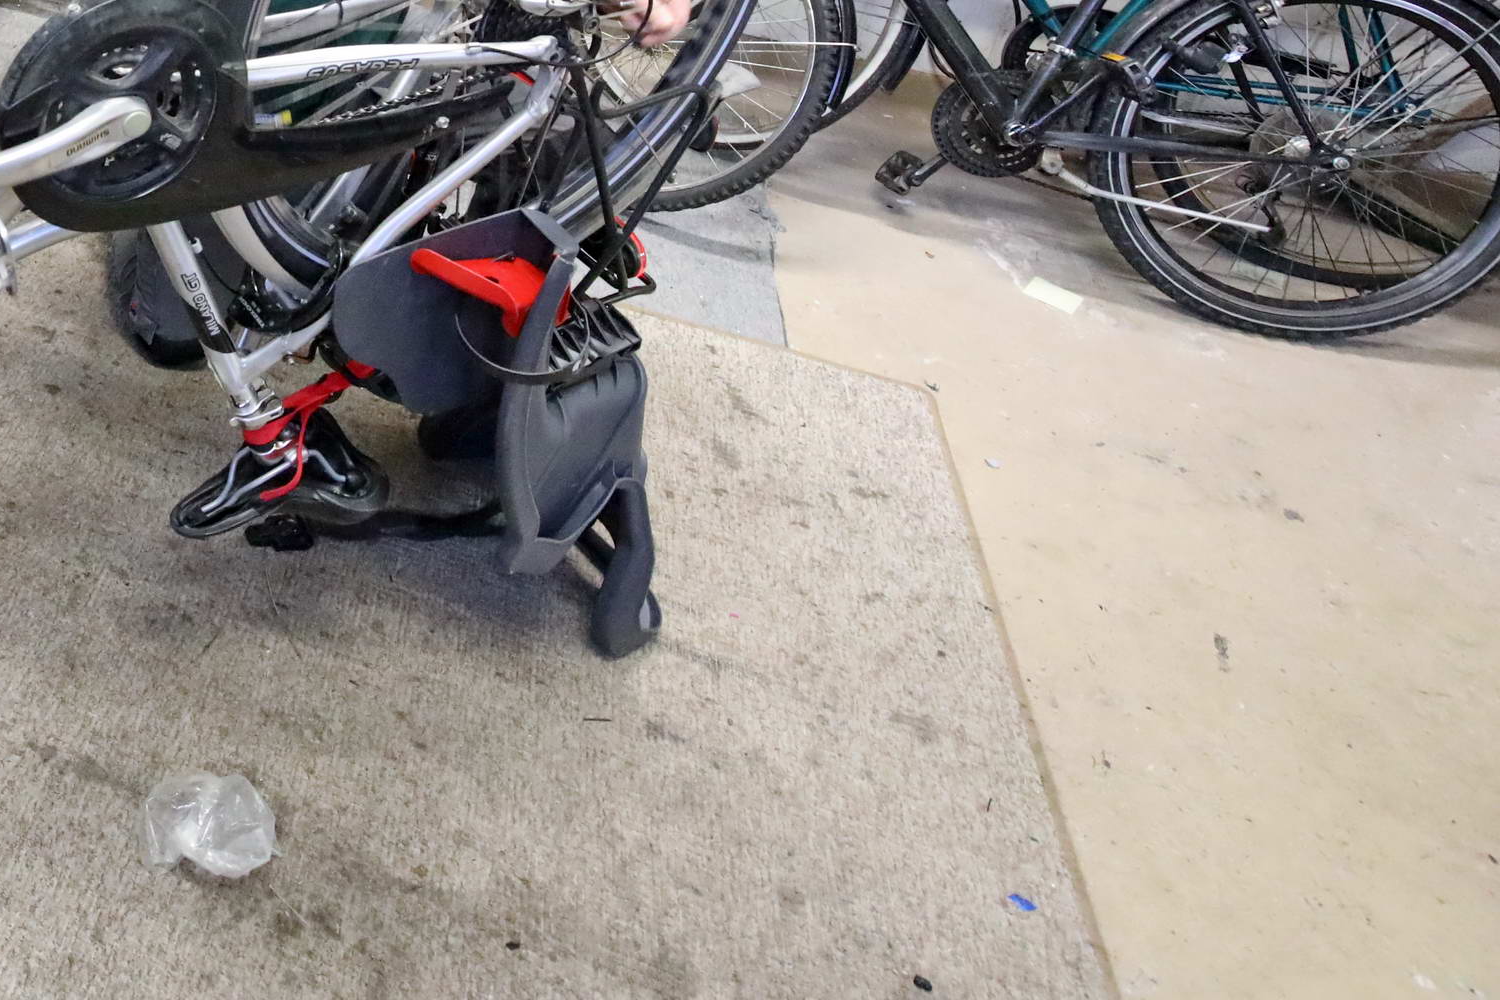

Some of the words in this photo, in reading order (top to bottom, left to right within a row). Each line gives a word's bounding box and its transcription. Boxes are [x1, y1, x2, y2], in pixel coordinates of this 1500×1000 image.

[305, 58, 421, 80] PEGASUS
[66, 127, 111, 157] SHIMANO
[180, 272, 201, 293] GT
[192, 292, 221, 336] MILANO
